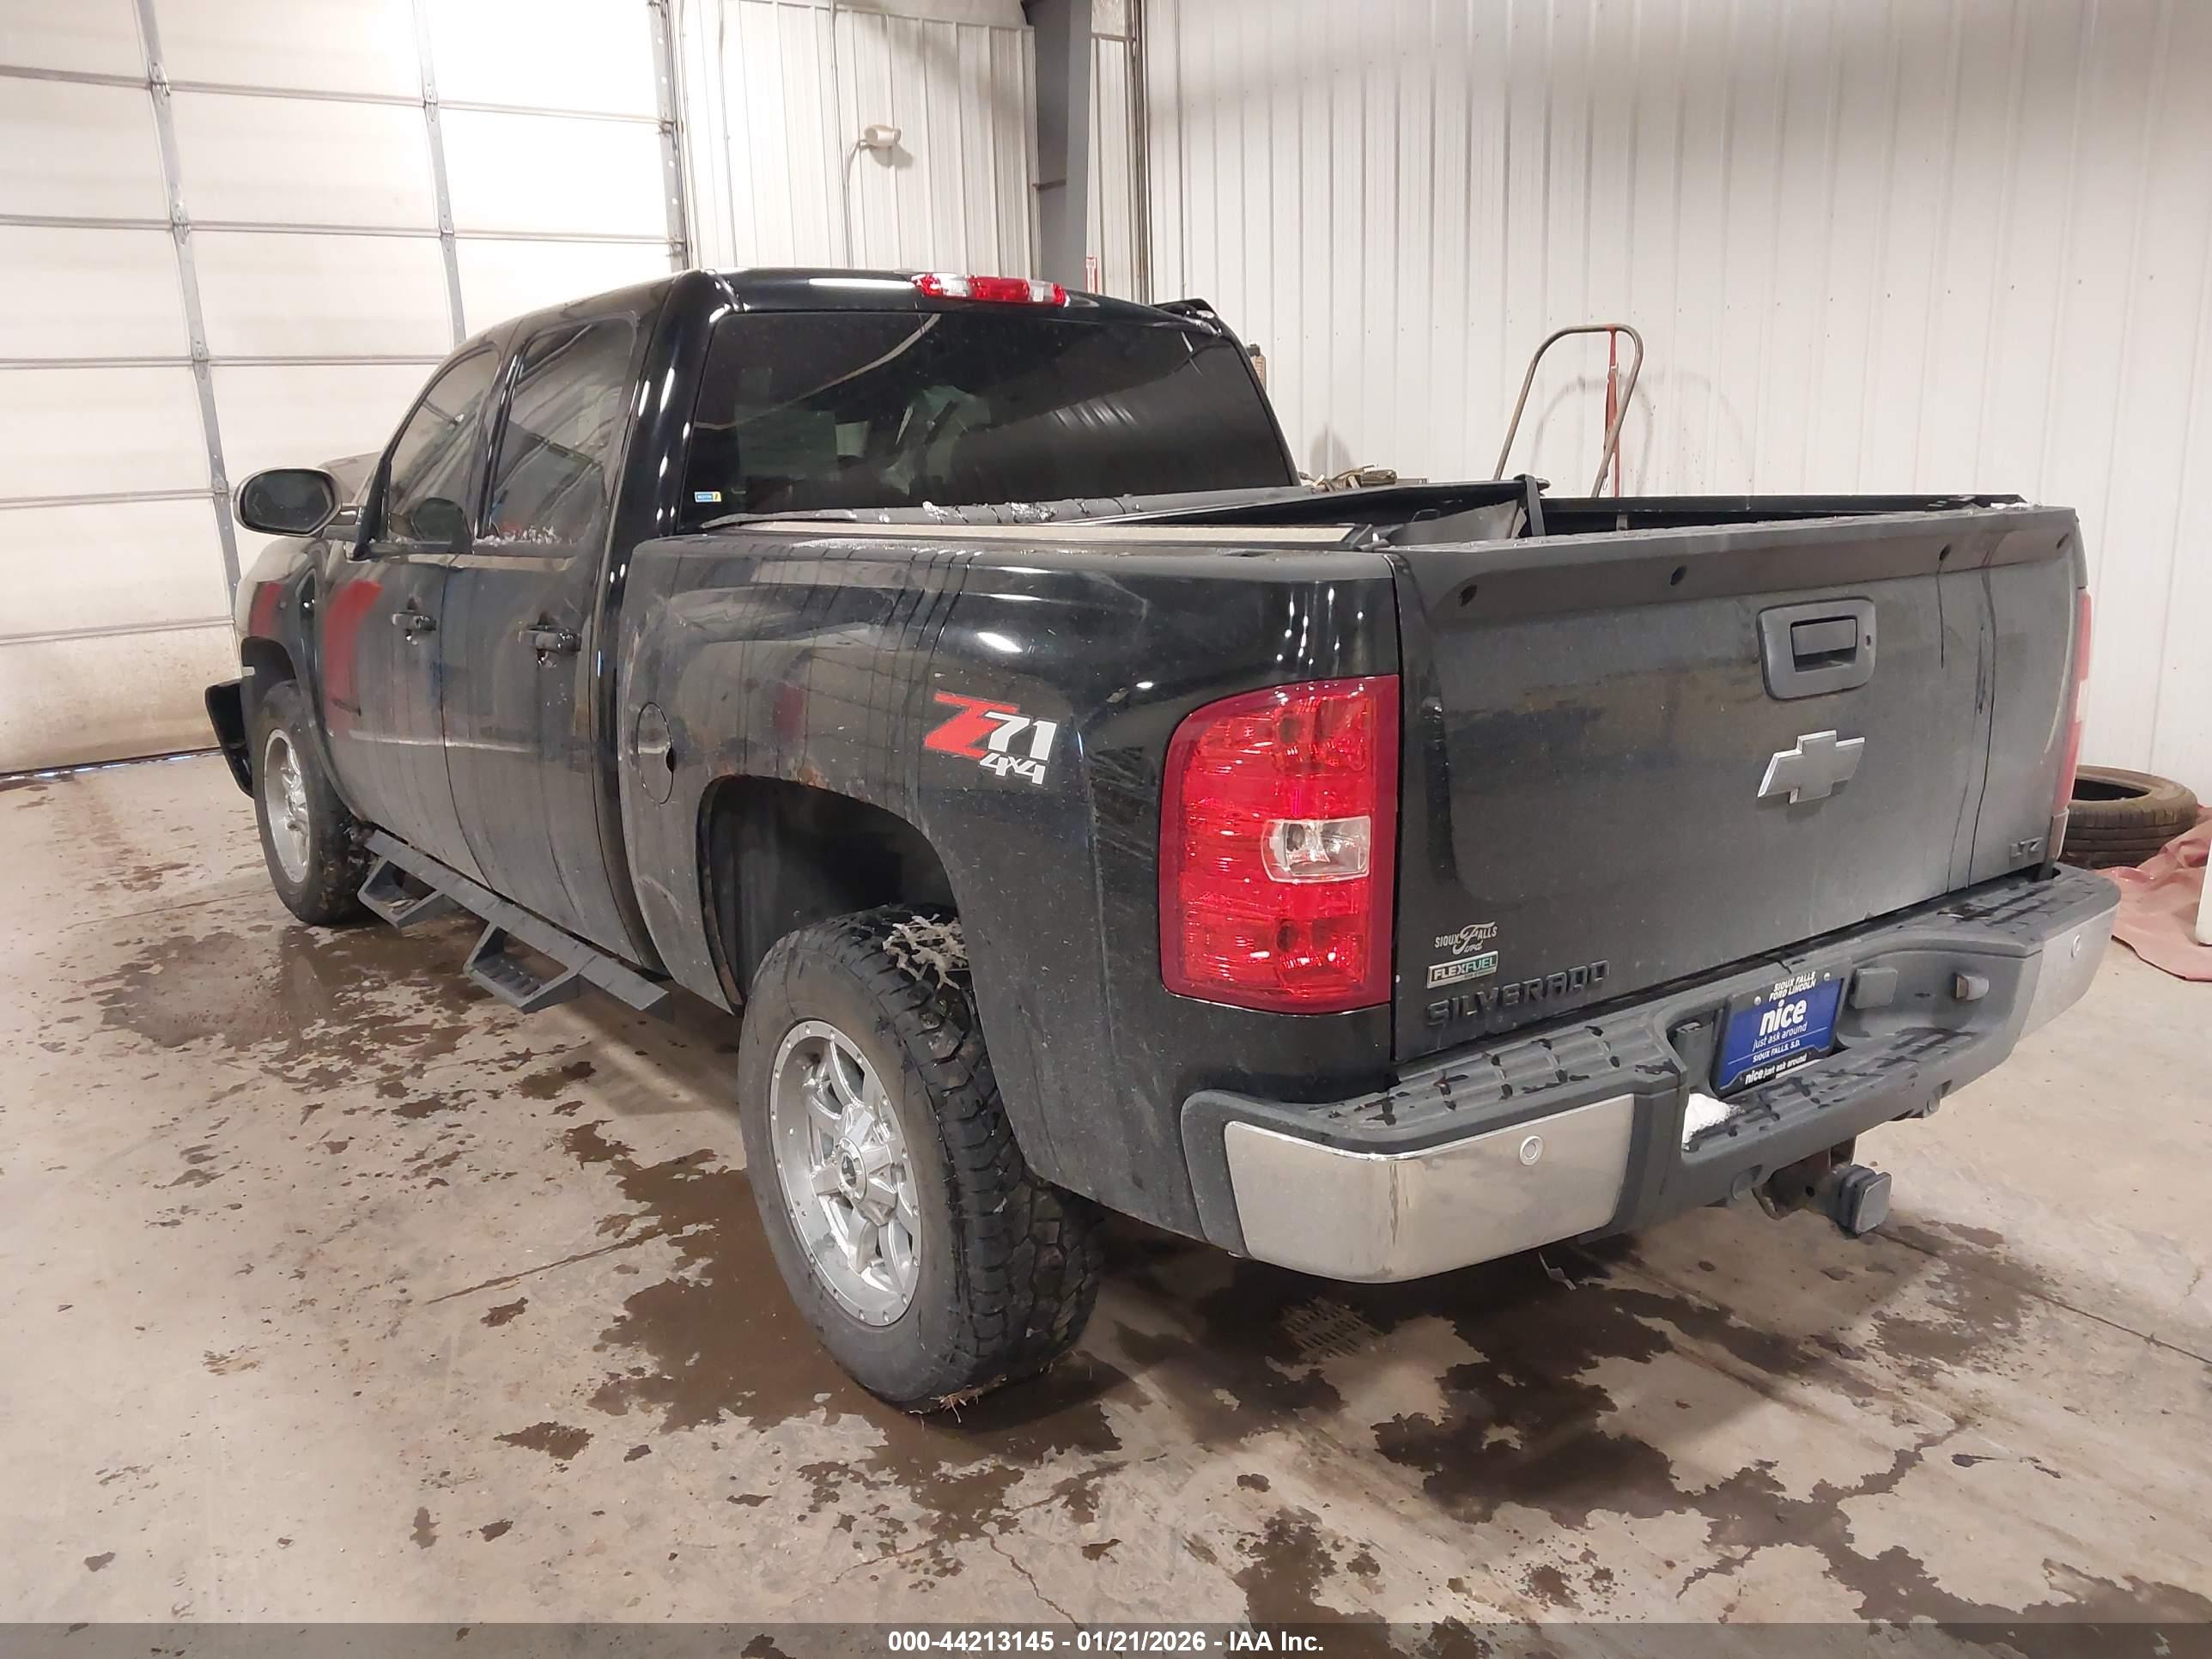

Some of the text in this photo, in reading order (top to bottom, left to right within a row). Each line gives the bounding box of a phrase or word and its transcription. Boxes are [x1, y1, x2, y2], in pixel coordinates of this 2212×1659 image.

[925, 692, 1057, 761] Z71
[2009, 836, 2044, 858] LTZ
[1434, 933, 1461, 949] SIOUX
[1433, 957, 1496, 981] FLEXFUEL
[1773, 970, 1816, 992] SIOUX FALLS
[1427, 959, 1610, 1027] SILVERADO
[1769, 978, 1817, 1003] FORD LINCOLN
[1759, 999, 1808, 1036] nice
[1752, 1021, 1808, 1053] just ask around
[1744, 1053, 1808, 1085] nice just ask around
[1753, 1050, 1771, 1063] SIOUX
